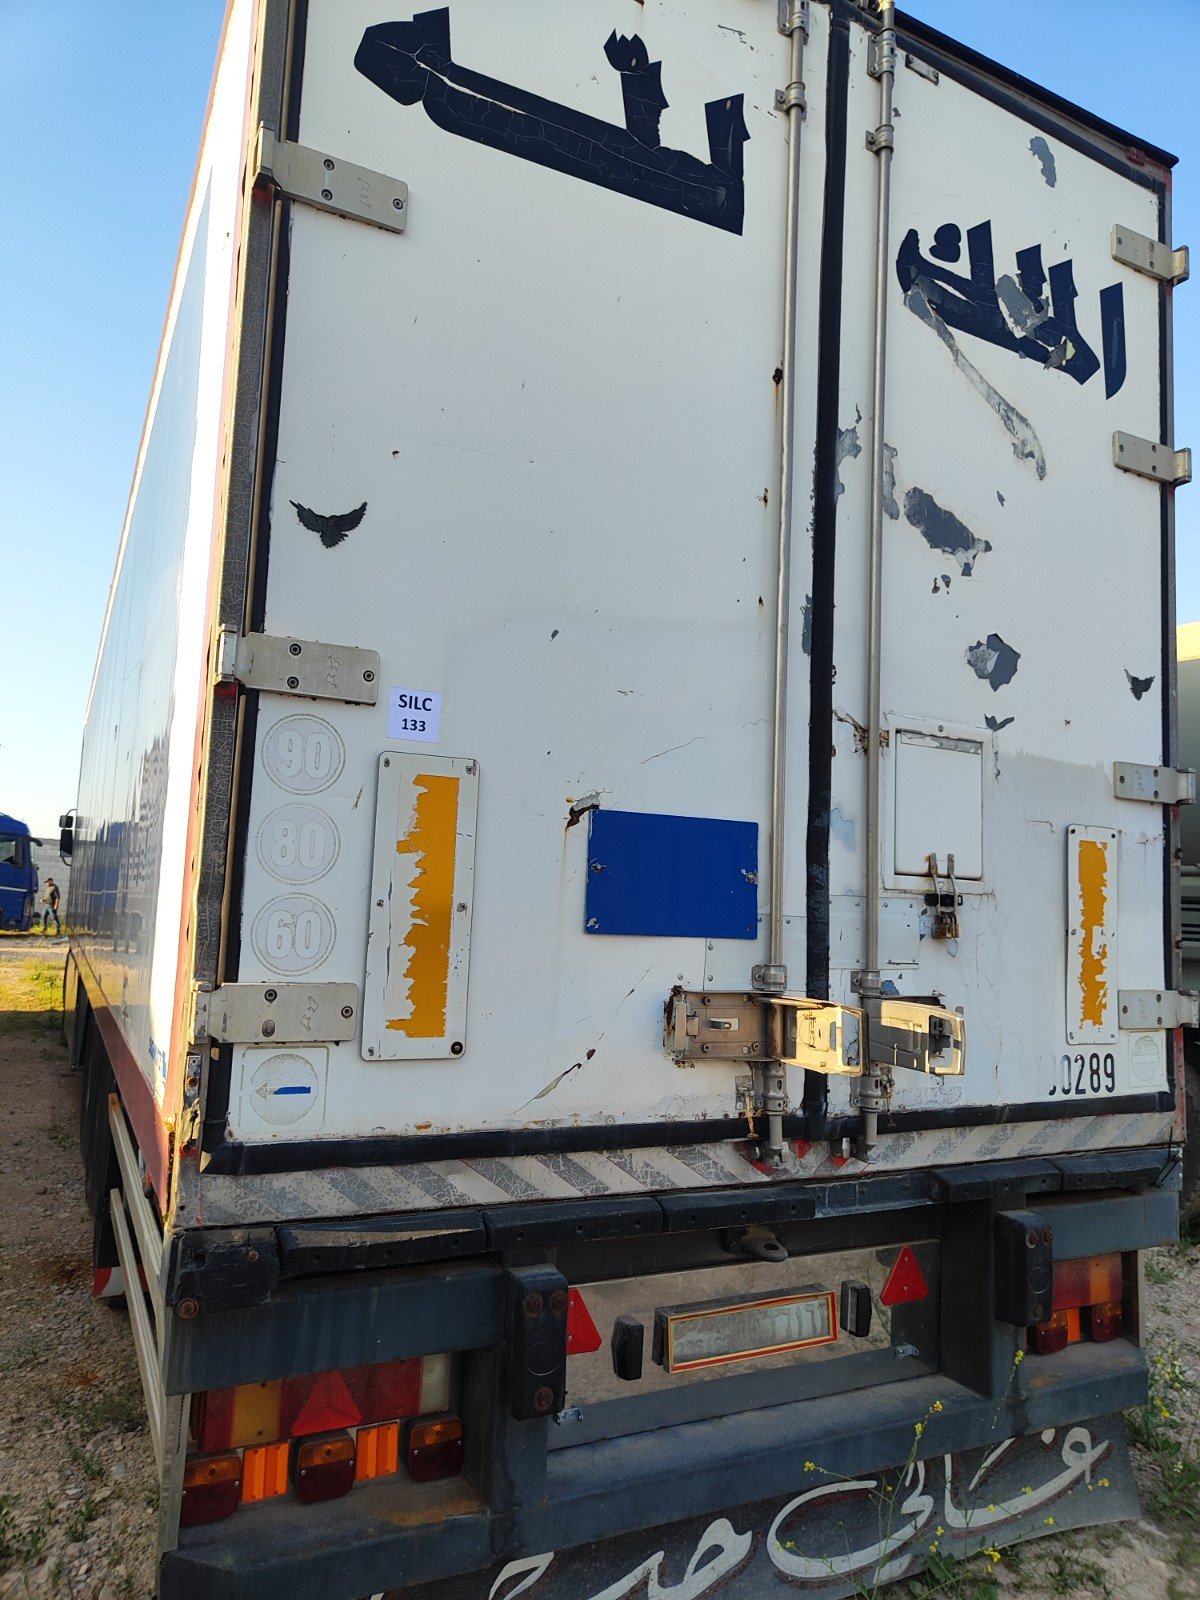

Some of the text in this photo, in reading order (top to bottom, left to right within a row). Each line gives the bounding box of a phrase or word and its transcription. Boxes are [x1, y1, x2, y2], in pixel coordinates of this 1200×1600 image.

[398, 694, 434, 712] SILC
[401, 717, 427, 732] 133
[277, 729, 332, 780] 90
[269, 819, 326, 869] 80
[266, 909, 323, 960] 60
[1047, 1052, 1116, 1096] 0289
